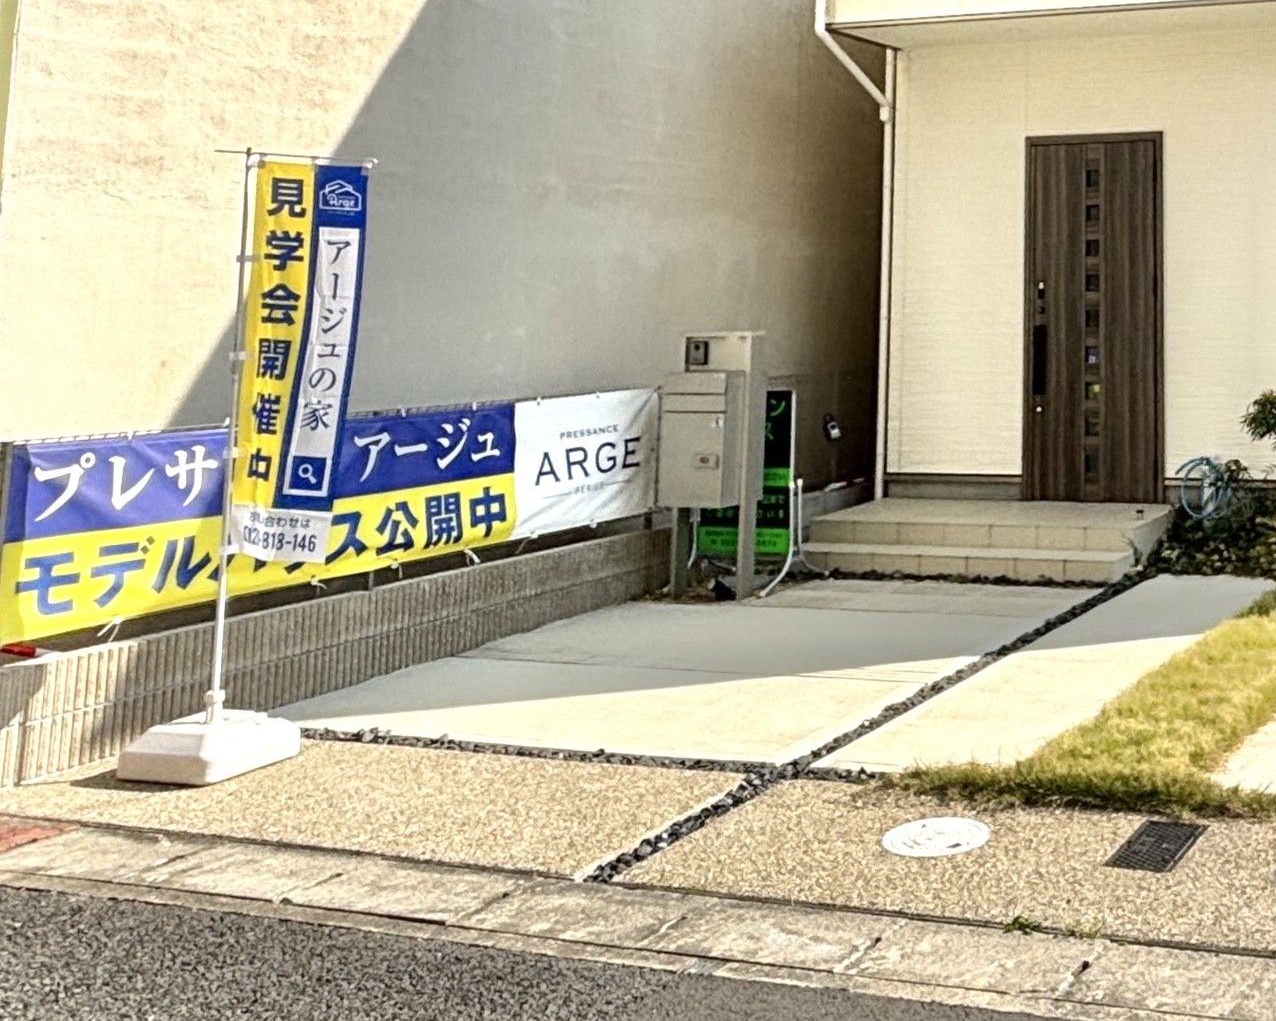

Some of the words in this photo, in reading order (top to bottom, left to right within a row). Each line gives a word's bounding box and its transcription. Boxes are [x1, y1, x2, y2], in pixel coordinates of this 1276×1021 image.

[247, 177, 306, 481] 見学会開催中
[301, 239, 351, 431] アージュの家
[34, 444, 219, 522] プレサ
[535, 436, 641, 486] ARGE
[560, 424, 619, 440] PRESSANCE
[15, 486, 507, 616] モデルス公開中
